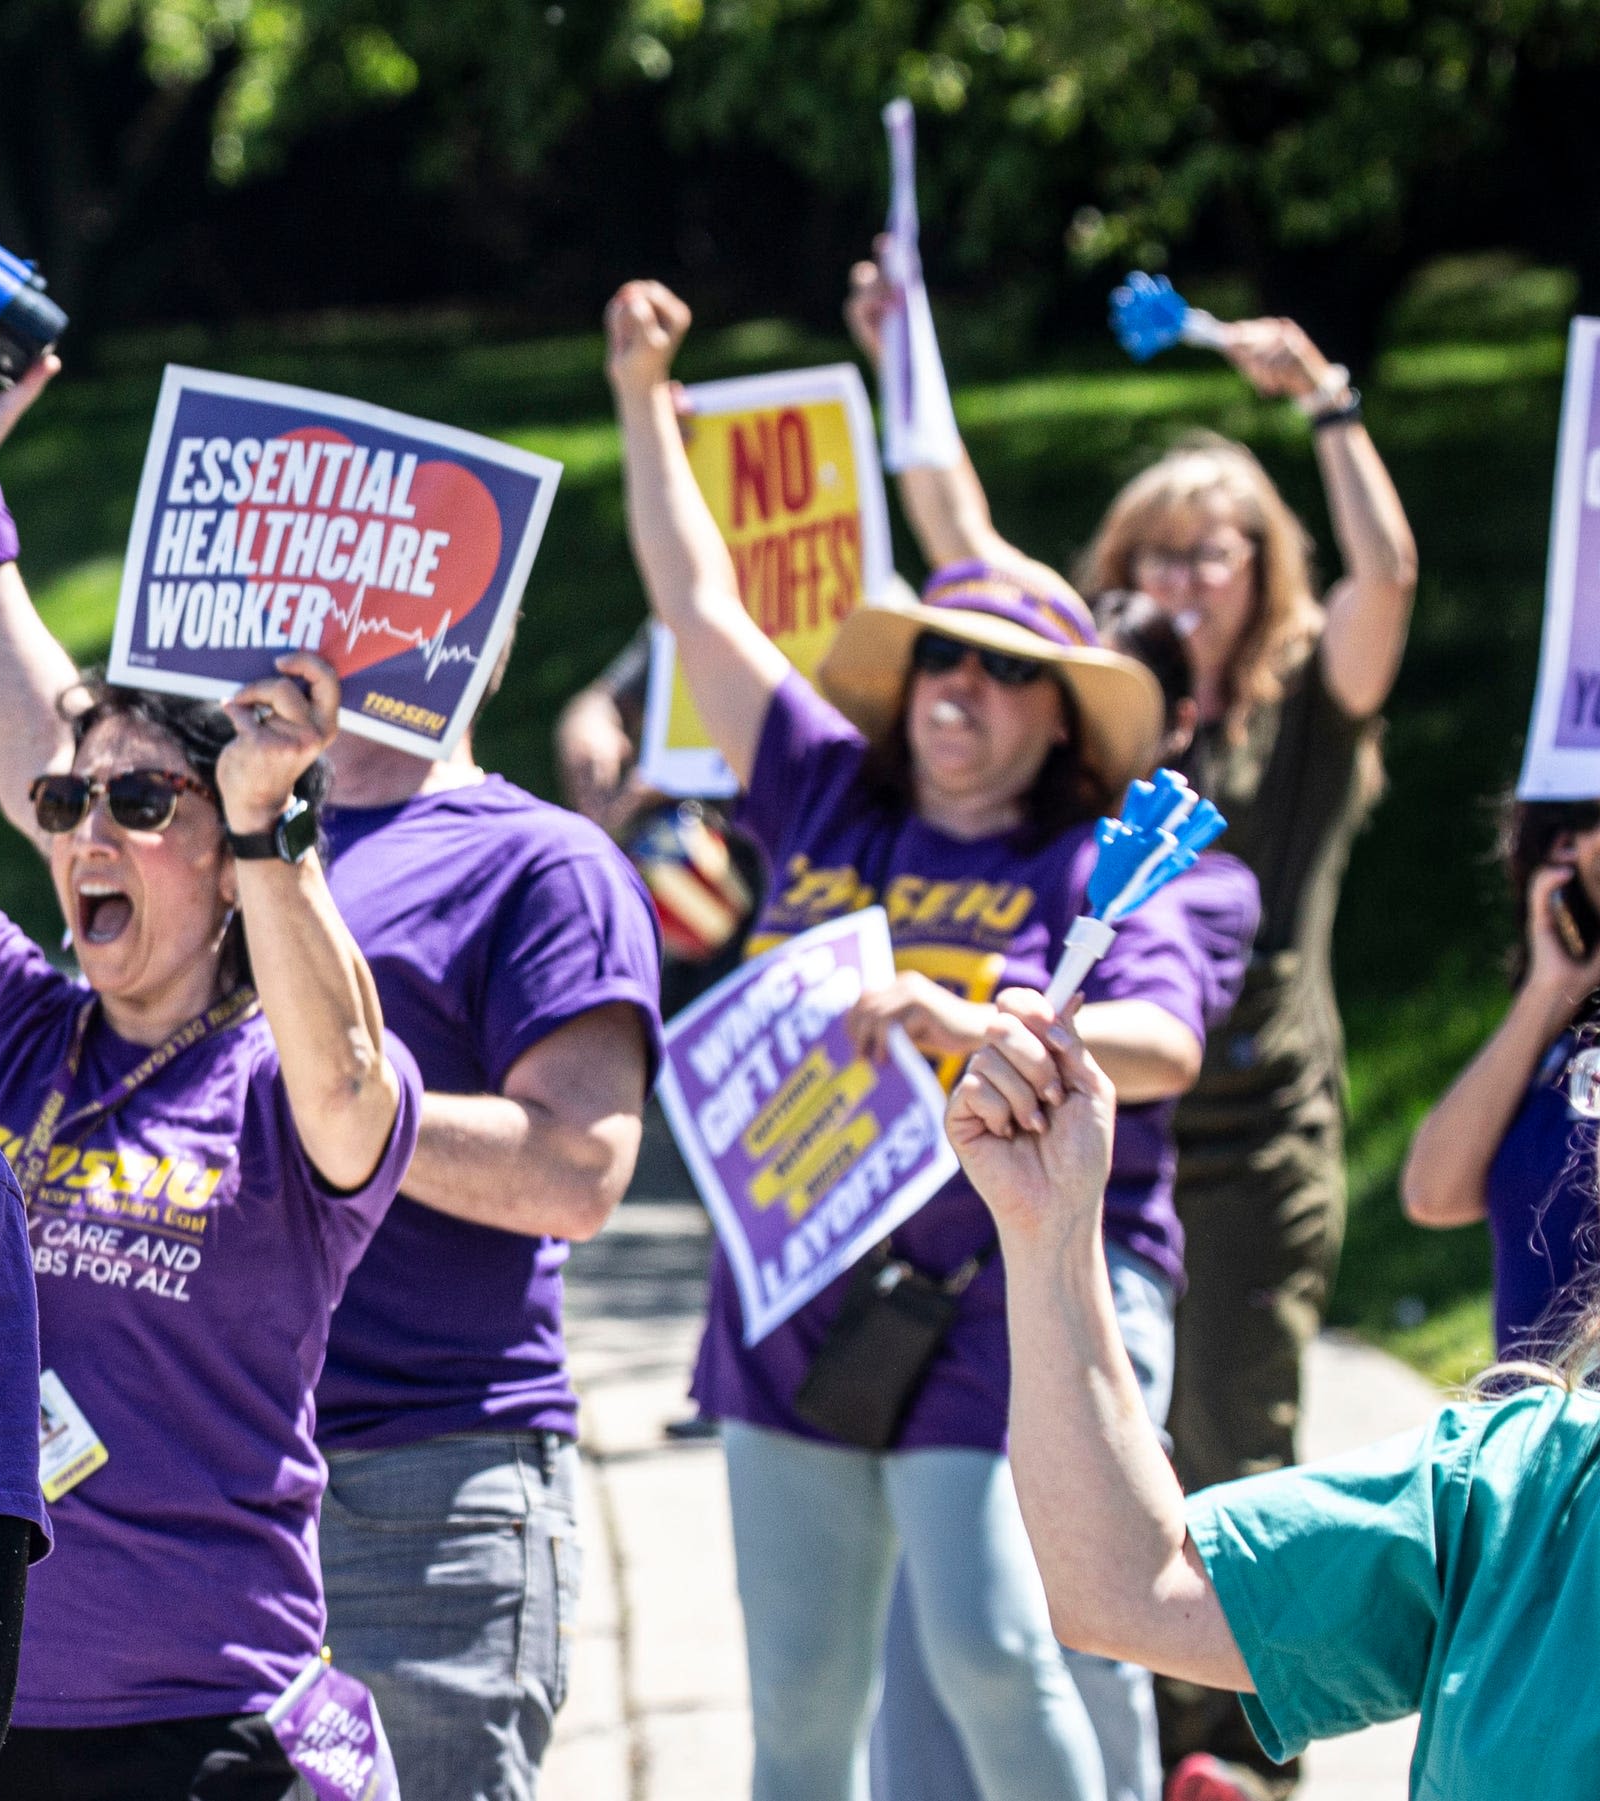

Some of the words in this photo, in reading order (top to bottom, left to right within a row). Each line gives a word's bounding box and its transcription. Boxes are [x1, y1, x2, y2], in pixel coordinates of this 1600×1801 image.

[167, 437, 419, 519] ESSENTIAL
[729, 406, 816, 530] NO
[152, 508, 450, 598] HEALTHCARE
[145, 580, 330, 651] WORKER
[32, 1247, 69, 1277] BS
[73, 1253, 132, 1289] FOR
[134, 1266, 191, 1302] ALL
[42, 1219, 124, 1256] CARE
[123, 1234, 202, 1273] AND
[317, 1700, 371, 1744] END
